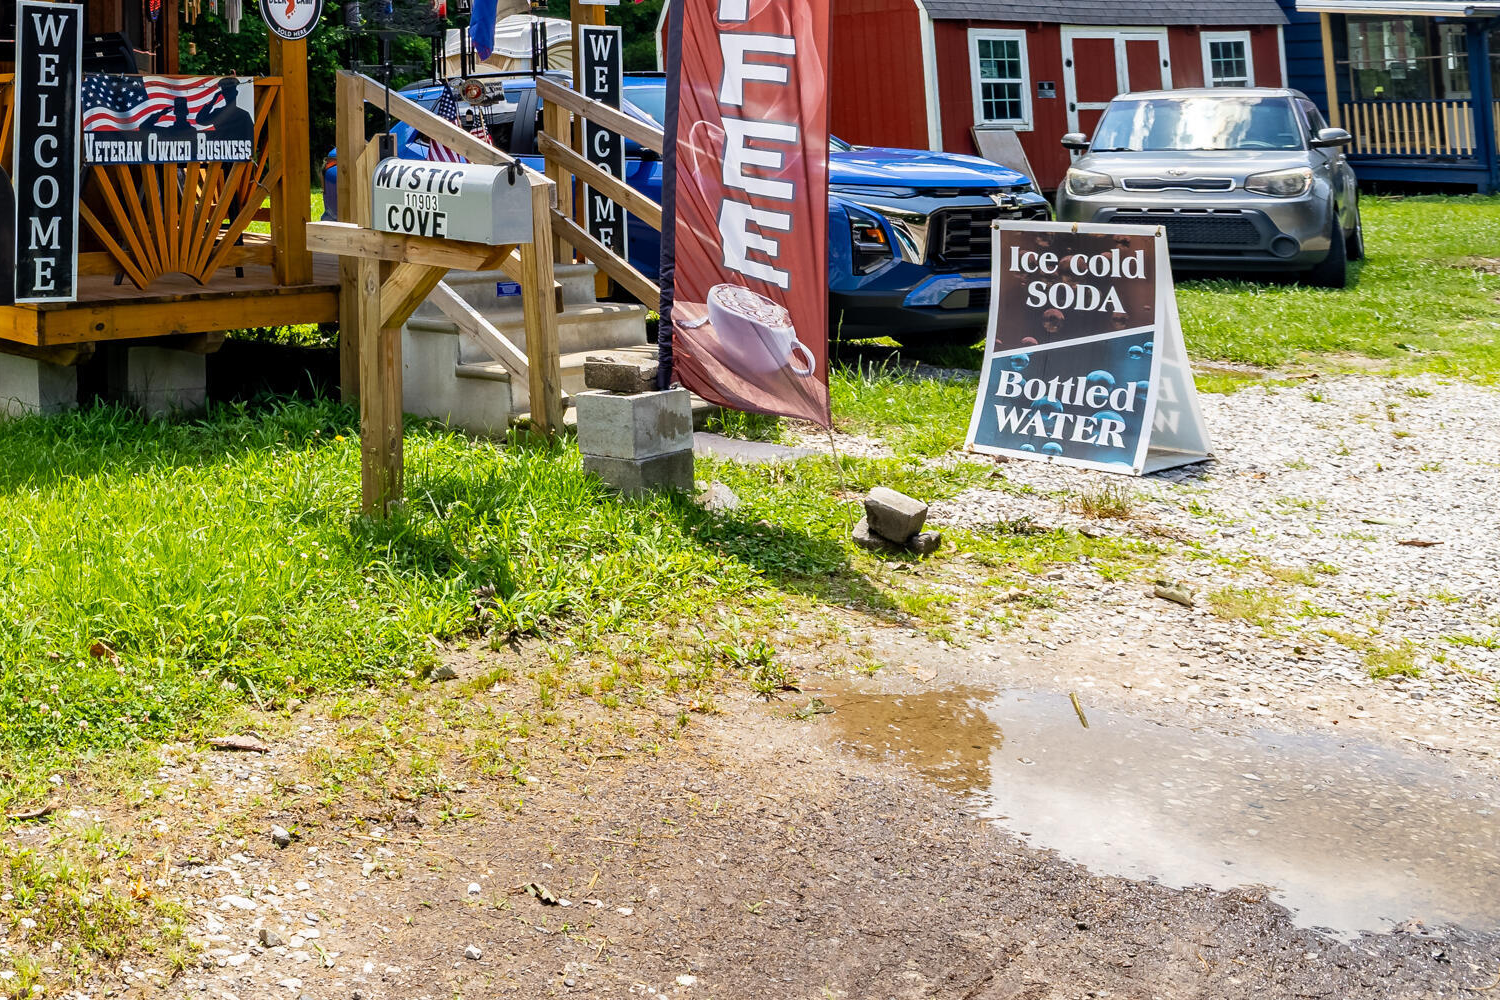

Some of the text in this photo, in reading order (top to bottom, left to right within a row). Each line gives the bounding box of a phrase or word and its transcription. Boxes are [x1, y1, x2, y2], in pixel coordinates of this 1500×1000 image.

[277, 27, 308, 37] SOLD HERE
[28, 13, 69, 291] WELCOME
[588, 34, 616, 251] WECME
[376, 164, 464, 195] MYSTIC
[406, 193, 438, 211] 10903
[387, 205, 446, 239] COVE
[1009, 246, 1147, 280] Ice cold
[1025, 280, 1127, 314] SODA
[994, 369, 1138, 413] Bottled
[994, 404, 1127, 449] WATER
